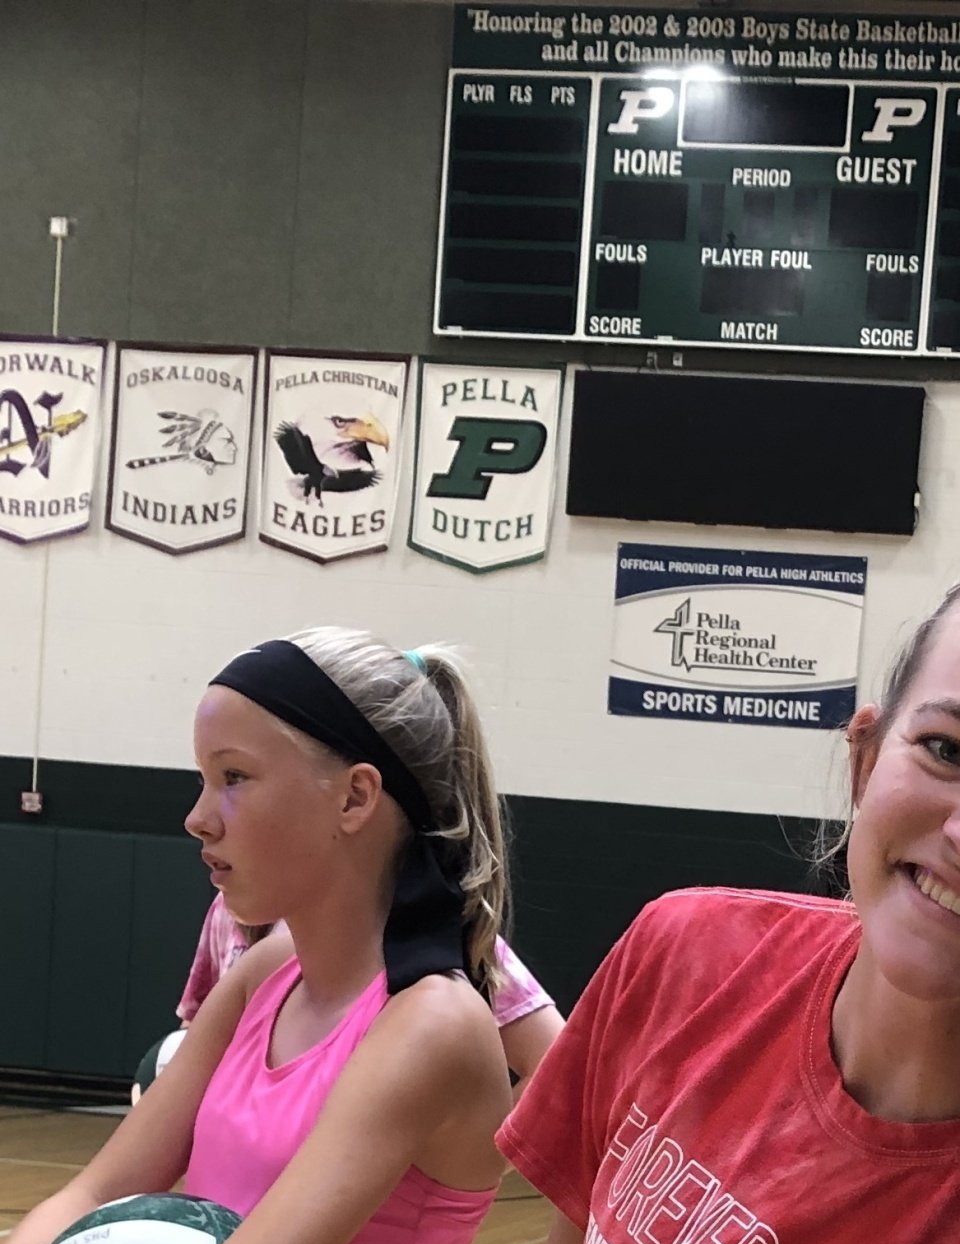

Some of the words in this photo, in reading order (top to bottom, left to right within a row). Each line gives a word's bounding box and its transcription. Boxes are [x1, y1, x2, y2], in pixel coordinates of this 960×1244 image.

[571, 13, 603, 34] the
[609, 14, 657, 36] 2002
[663, 14, 680, 37] &
[686, 16, 736, 38] 2003
[741, 16, 790, 44] Boys
[795, 18, 850, 40] State
[541, 39, 577, 62] and
[583, 40, 608, 62] all
[614, 40, 725, 66] Champions
[731, 45, 773, 67] who
[778, 46, 832, 67] make
[838, 48, 878, 70] this
[885, 48, 935, 70] their
[462, 83, 495, 103] PLYR
[509, 85, 533, 104] FLS
[550, 86, 576, 105] PTS
[607, 87, 675, 134] P
[861, 98, 927, 142] P
[613, 149, 683, 177] HOME
[836, 155, 917, 184] GUEST
[732, 167, 792, 188] PERIOD
[595, 243, 648, 263] FOULS
[701, 247, 764, 268] PLAYER
[770, 250, 812, 270] FOUL
[865, 254, 919, 274] FOULS
[589, 316, 642, 336] SCORE
[720, 321, 778, 341] MATCH
[860, 327, 914, 348] SCORE
[126, 365, 245, 395] OSKALOOSA
[275, 373, 320, 392] PELLA
[322, 370, 399, 398] CHRISTIAN
[441, 378, 539, 413] PELLA
[425, 415, 548, 501] P
[122, 490, 237, 526] INDIANS
[273, 501, 386, 538] EAGLES
[431, 508, 534, 543] DUTCH
[620, 558, 666, 573] OFFICIAL
[668, 560, 719, 576] PROVIDER
[722, 563, 743, 577] FOR
[745, 566, 778, 581] PELLA
[780, 568, 807, 581] HIGH
[808, 570, 864, 585] ATHLETICS
[697, 612, 740, 631] Pella
[696, 629, 776, 651] Regional
[694, 648, 754, 668] Health
[756, 652, 818, 671] Center
[642, 690, 717, 714] SPORTS
[723, 697, 821, 722] MEDICINE
